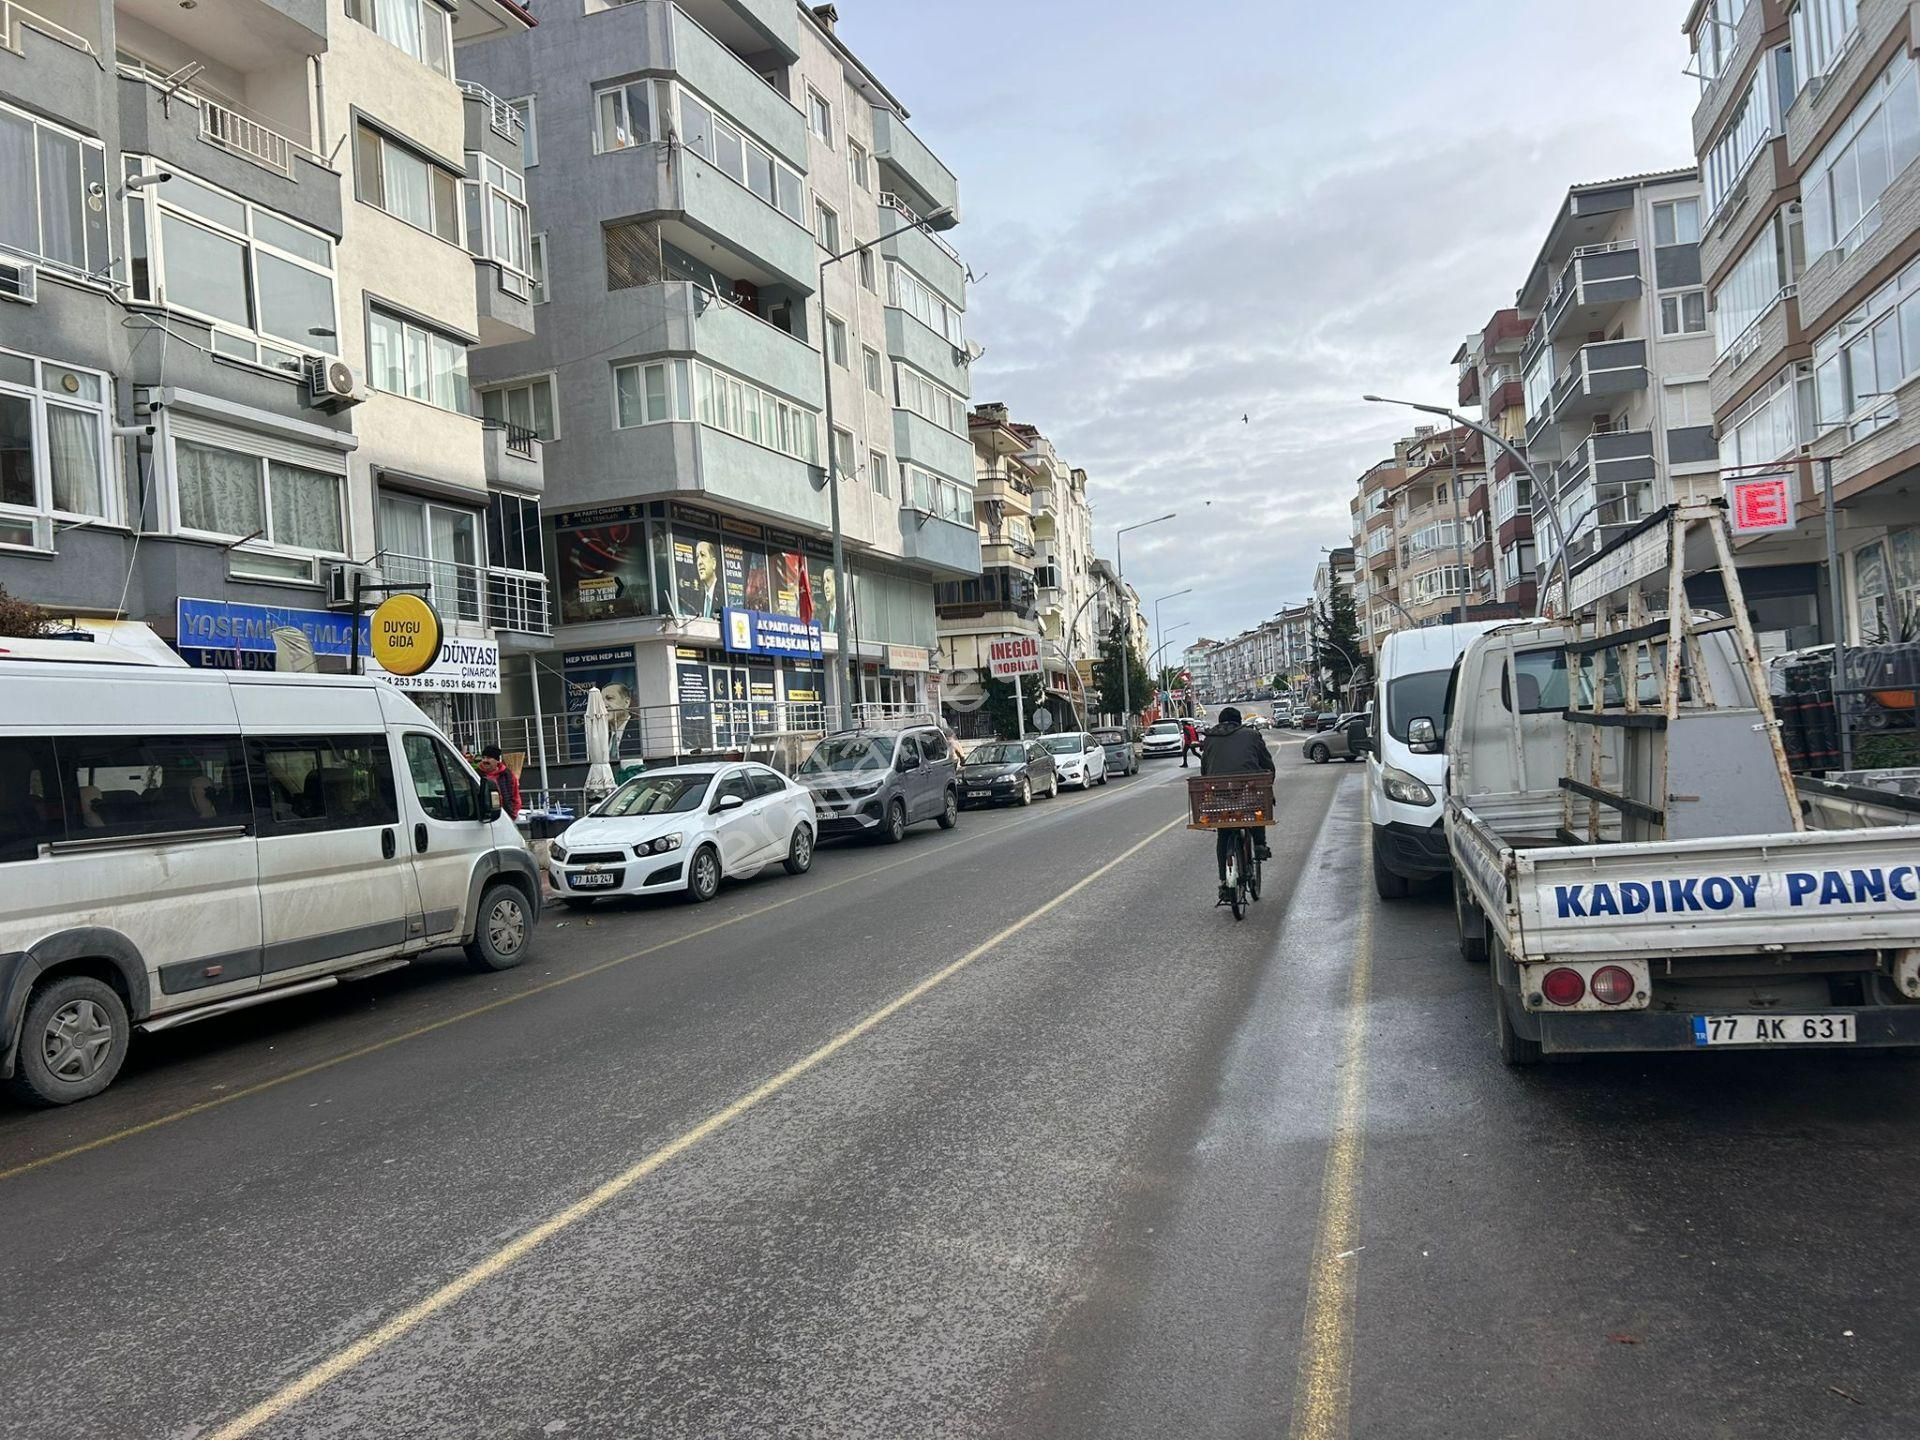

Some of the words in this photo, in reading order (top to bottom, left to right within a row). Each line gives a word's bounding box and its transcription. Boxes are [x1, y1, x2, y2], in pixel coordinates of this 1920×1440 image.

[1745, 487, 1777, 520] E
[580, 595, 595, 603] HEP
[383, 620, 420, 633] DUYGU
[757, 619, 768, 630] AK
[388, 635, 414, 647] GIDA
[441, 640, 498, 666] DÜNYASI
[990, 636, 1039, 661] İNEGÖL
[565, 656, 580, 664] HEP
[599, 652, 613, 660] HEP
[461, 666, 497, 678] ÇINARCIK
[993, 659, 1039, 675] MOBİLYA
[394, 677, 410, 687] 253
[412, 678, 422, 687] 75
[424, 678, 434, 687] 85
[440, 679, 459, 688] 0531
[461, 680, 475, 689] 646
[477, 680, 486, 689] 77
[488, 681, 497, 689] 14
[1554, 874, 1761, 919] KADIKOY
[1785, 865, 1920, 907] PANC
[1695, 1032, 1707, 1041] TR
[1708, 1019, 1738, 1041] 77
[1756, 1019, 1786, 1040] AK
[1803, 1018, 1848, 1039] 631
